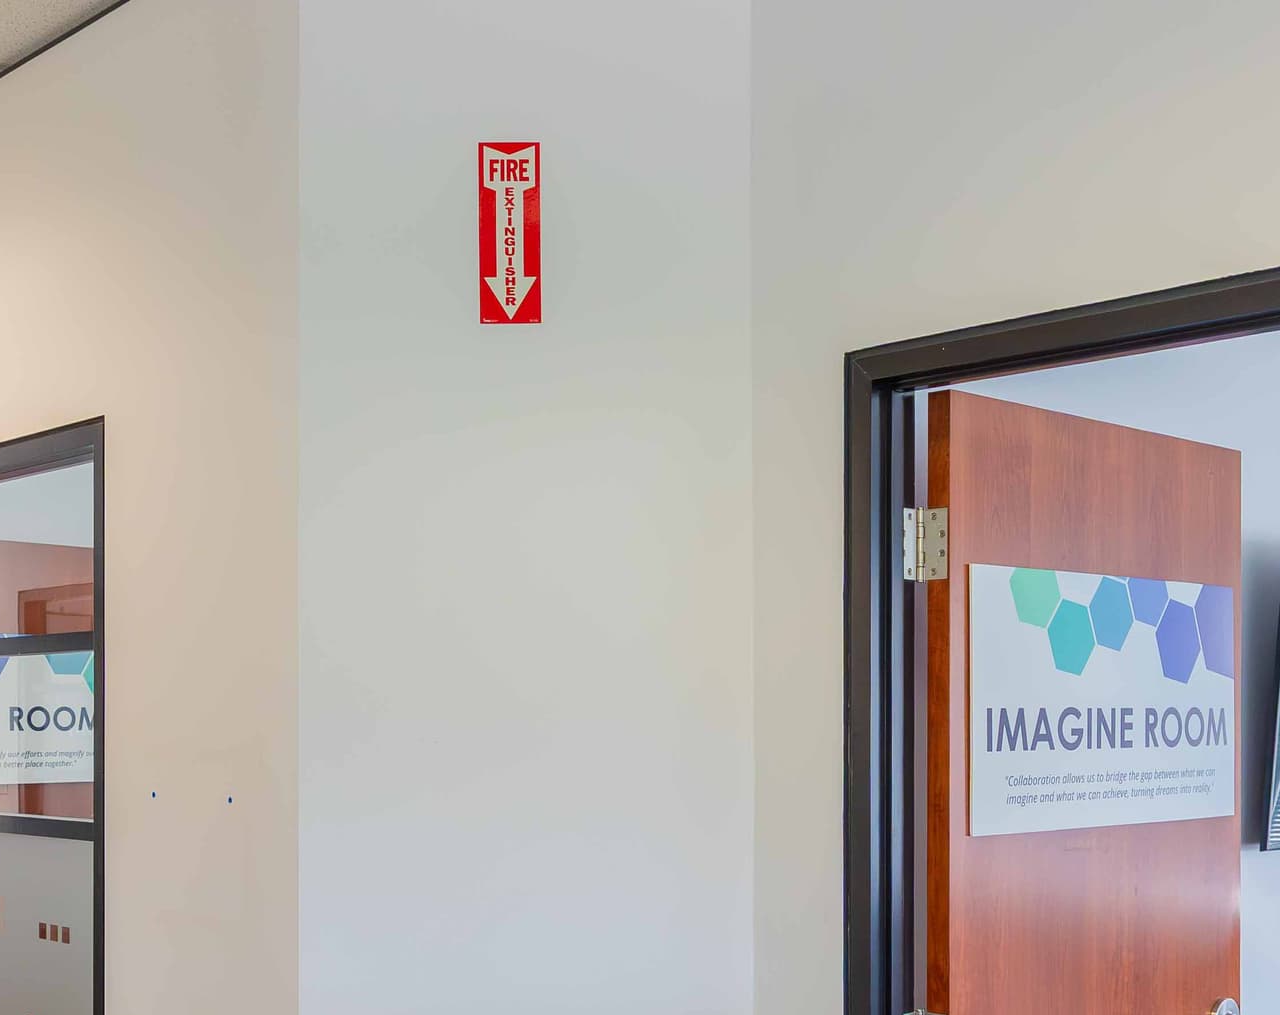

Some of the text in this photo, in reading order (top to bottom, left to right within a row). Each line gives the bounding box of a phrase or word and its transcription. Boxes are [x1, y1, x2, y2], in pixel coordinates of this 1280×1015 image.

[489, 159, 530, 182] FIRE
[504, 187, 517, 306] EXTINGUISHER
[986, 706, 1228, 752] IMAGINE ROOM
[3, 761, 24, 769] better
[25, 760, 44, 769] place
[20, 750, 44, 760] efforts
[44, 750, 58, 758] and
[59, 750, 84, 760] magnify
[1005, 768, 1216, 787] "Collaboration allows us to bridge the gap between what we can
[1006, 792, 1038, 807] imagine
[1039, 791, 1055, 803] and
[1056, 790, 1075, 801] what
[1076, 790, 1087, 800] we
[1088, 790, 1101, 801] can
[1102, 787, 1129, 799] achieve,
[1130, 786, 1155, 799] turning
[1155, 785, 1179, 796] dreams
[1179, 784, 1192, 794] into
